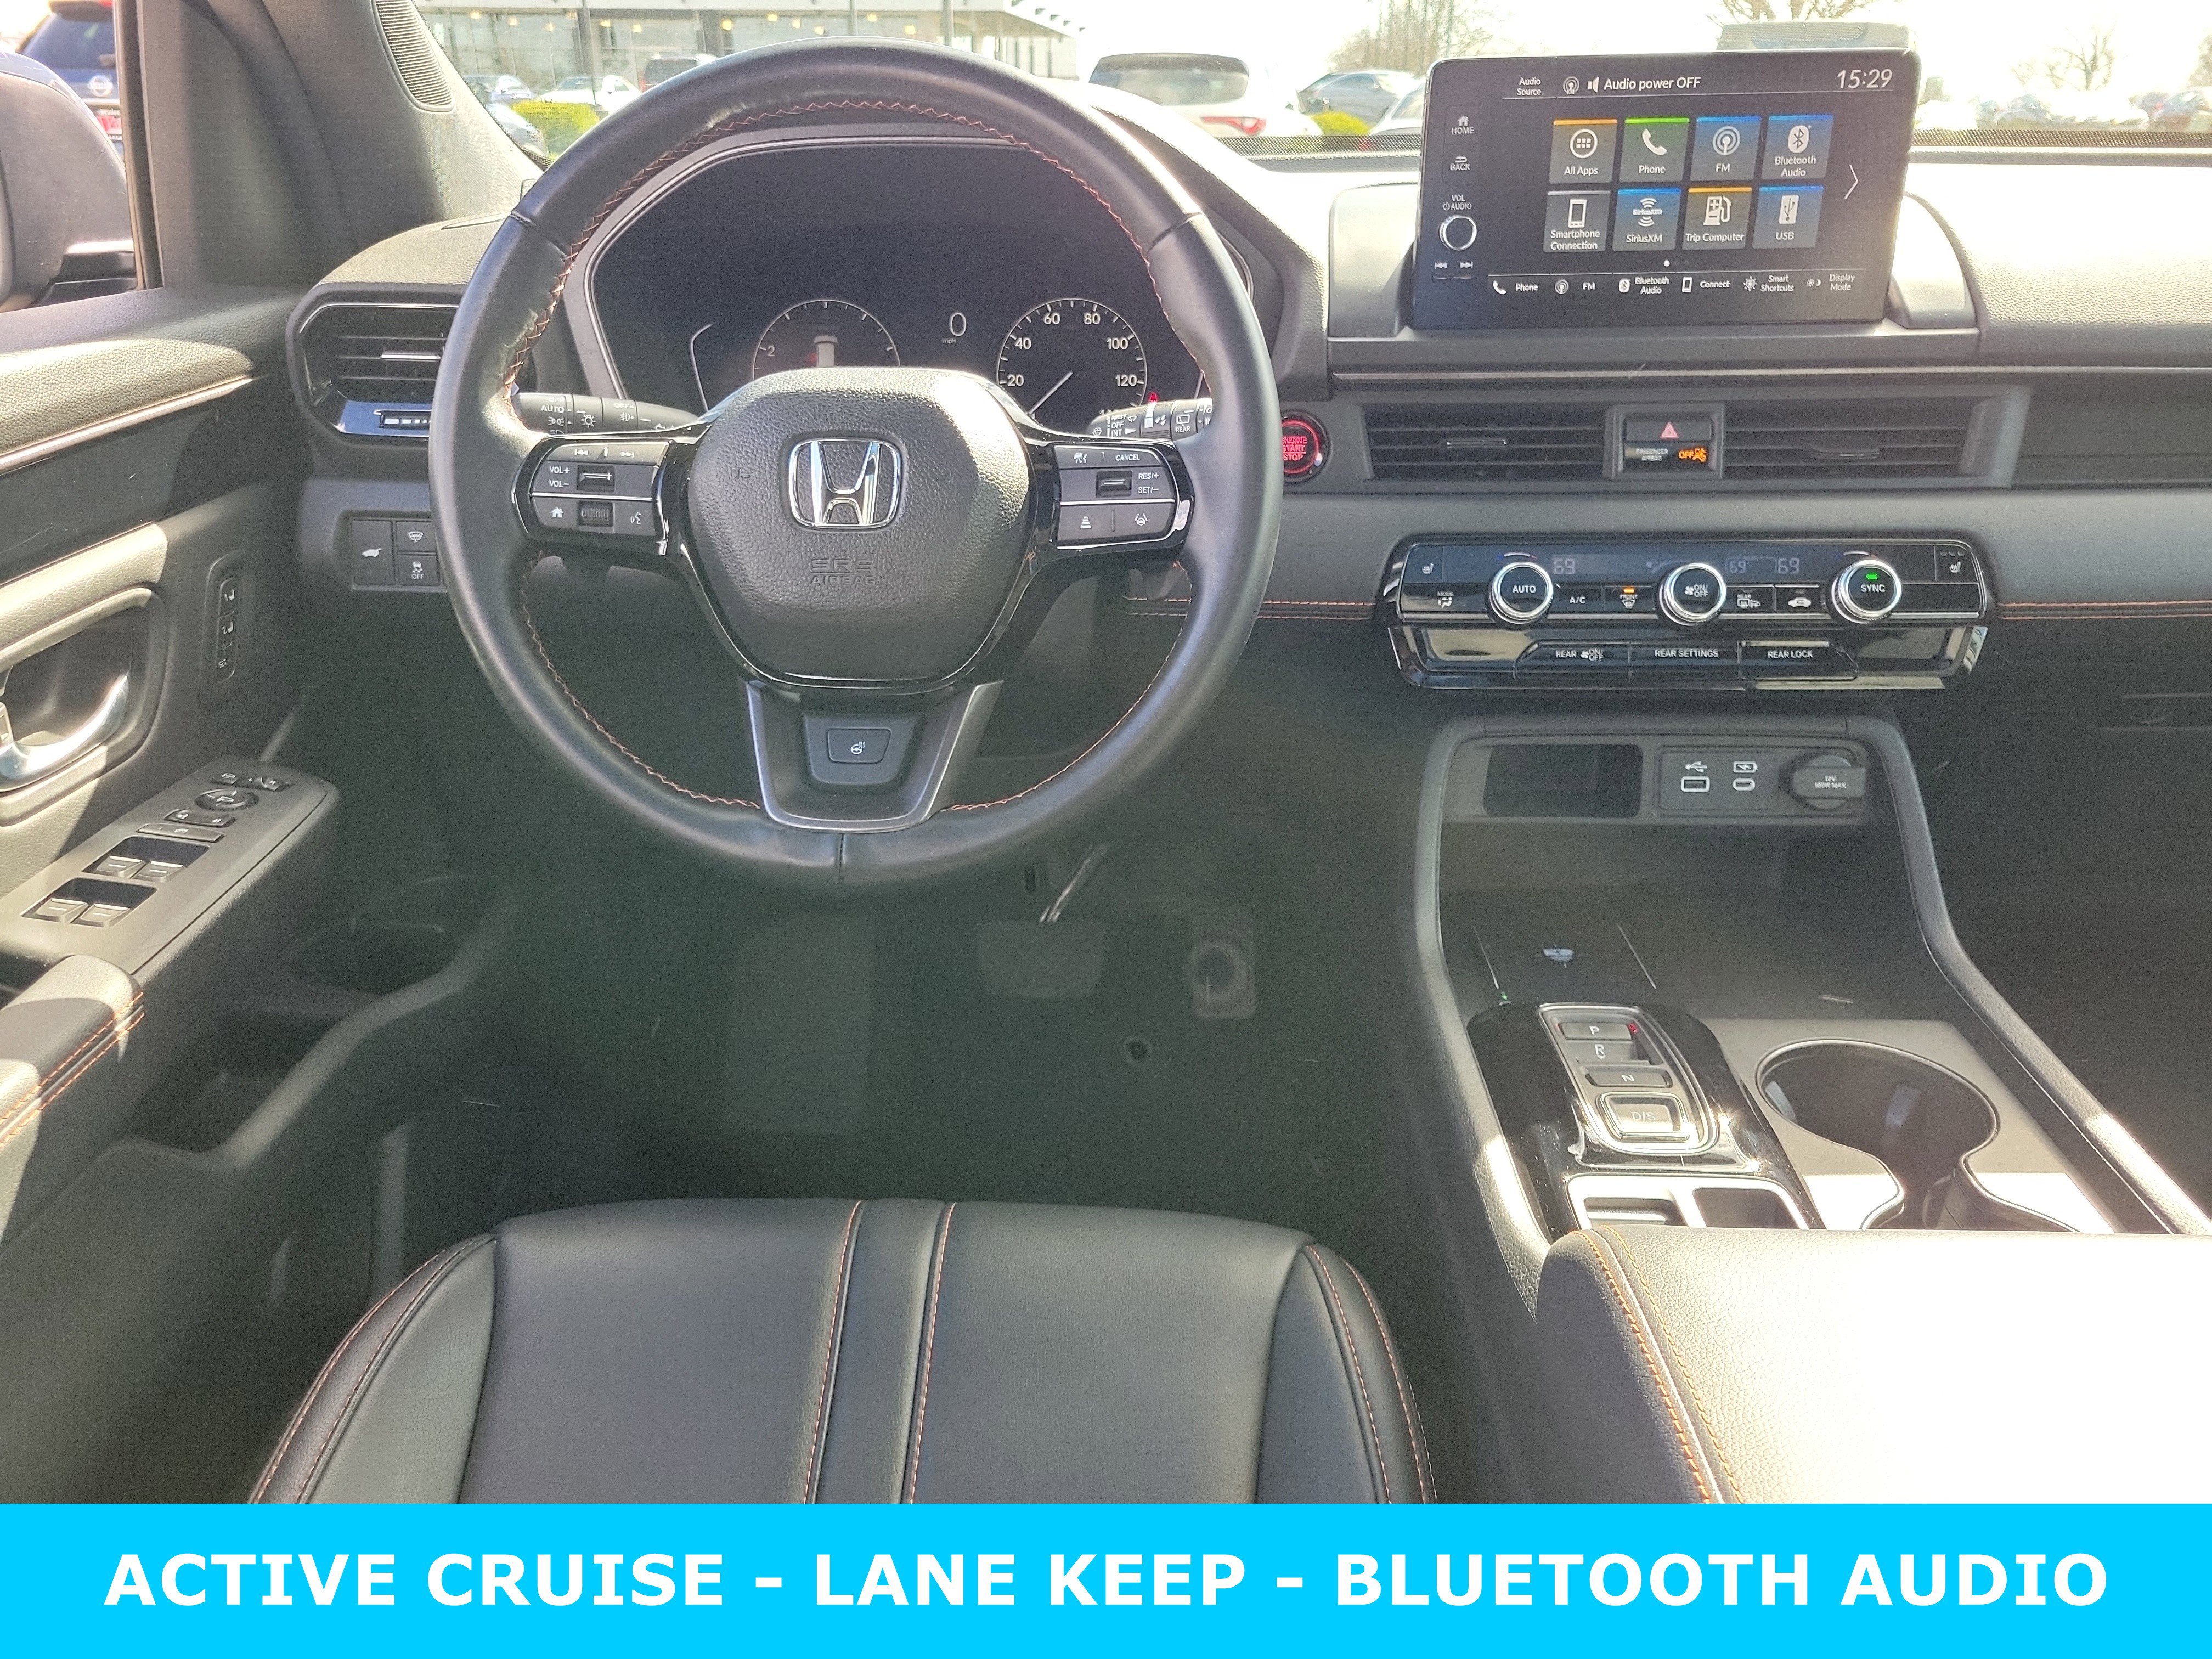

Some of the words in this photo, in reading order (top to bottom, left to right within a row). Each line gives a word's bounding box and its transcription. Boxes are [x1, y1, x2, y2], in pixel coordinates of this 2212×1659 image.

[1519, 77, 1542, 86] Audio
[1837, 68, 1893, 89] 15:29
[1604, 78, 1637, 89] Audio
[1639, 79, 1674, 92] power
[1676, 76, 1701, 89] OFF
[1516, 88, 1542, 96] Source
[1451, 126, 1475, 134] HOME
[1775, 155, 1816, 166] Bluetooth
[1449, 163, 1471, 171] BACK
[1564, 166, 1576, 175] All
[1577, 166, 1599, 177] Apps
[1638, 165, 1666, 174] Phone
[1715, 163, 1730, 172] FM
[1781, 168, 1807, 177] Audio
[1451, 202, 1472, 210] AUDIO
[1550, 229, 1600, 240] Smartphone
[1626, 234, 1663, 243] SiriusXM
[1685, 234, 1701, 243] Trip
[1702, 233, 1745, 243] Computer
[1775, 231, 1795, 240] USB
[1550, 241, 1598, 251] Connection
[1635, 276, 1670, 285] Bluetooth
[1768, 274, 1789, 283] Smart
[1829, 273, 1855, 283] Display
[1515, 283, 1539, 291] Phone
[1583, 282, 1596, 291] FM
[1700, 280, 1730, 289] Connect
[1760, 283, 1795, 292] Shortcuts
[1830, 283, 1852, 291] Mode
[1640, 286, 1662, 295] Audio
[1043, 313, 1060, 325] 60
[1084, 313, 1101, 325] 80
[950, 312, 967, 336] 0
[1015, 337, 1032, 349] 40
[1106, 337, 1128, 349] 100
[768, 346, 775, 357] 2
[1007, 374, 1024, 386] 20
[1115, 374, 1137, 386] 120
[541, 404, 565, 413] AUTO
[1111, 428, 1122, 437] INT
[1679, 450, 1694, 459] OFF
[549, 466, 571, 475] VOL+
[811, 558, 874, 572] SRS
[1553, 558, 1575, 575] 69
[1730, 560, 1746, 573] 69
[1778, 557, 1799, 574] 69
[810, 575, 876, 586] AIRBAG
[1512, 585, 1537, 593] AUTO
[1860, 584, 1886, 592] SYNC
[1569, 596, 1587, 604] A/C
[1678, 649, 1719, 658] SETTINGS
[1767, 650, 1790, 658] REAR
[1791, 650, 1814, 658] LOCK
[1589, 1026, 1600, 1035] P
[1594, 1045, 1605, 1057] R
